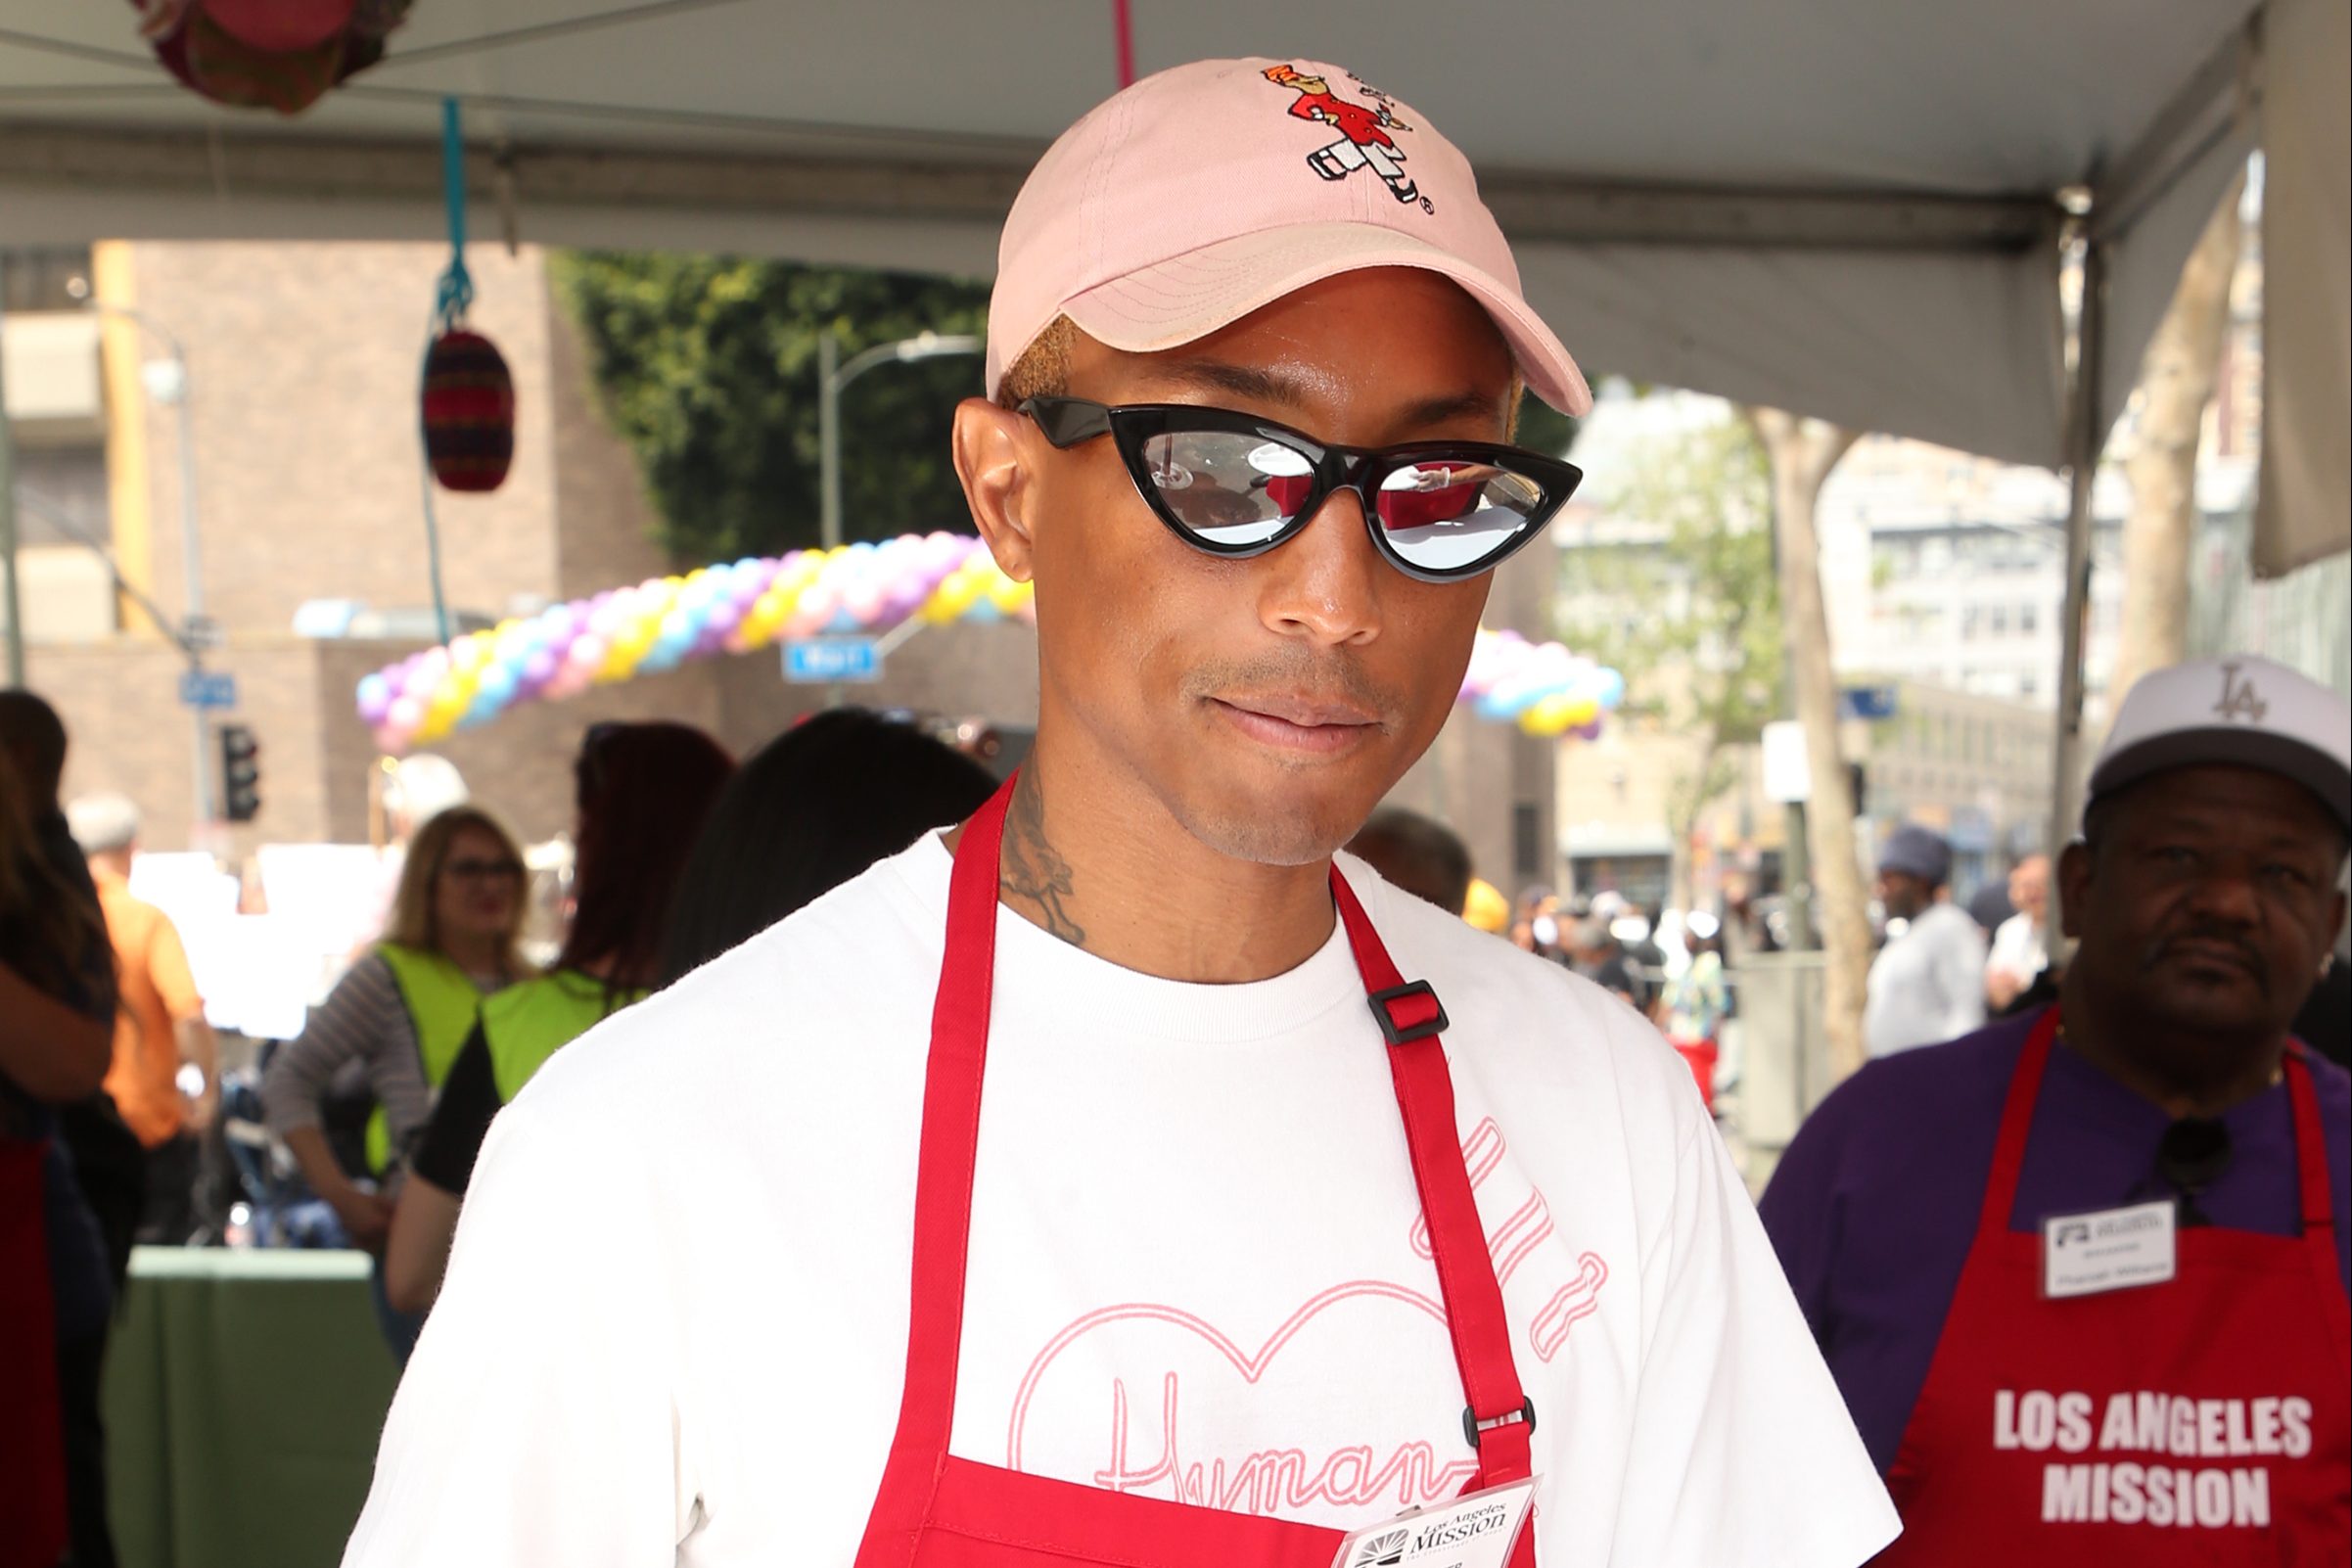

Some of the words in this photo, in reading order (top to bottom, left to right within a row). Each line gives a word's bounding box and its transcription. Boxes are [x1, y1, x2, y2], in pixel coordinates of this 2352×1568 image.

[2212, 664, 2267, 721] LA
[1993, 1388, 2094, 1453] LOS
[2098, 1390, 2313, 1458] ANGELES
[1423, 1523, 1448, 1535] Los
[1450, 1502, 1506, 1524] Angeles
[2041, 1461, 2272, 1528] MISSION
